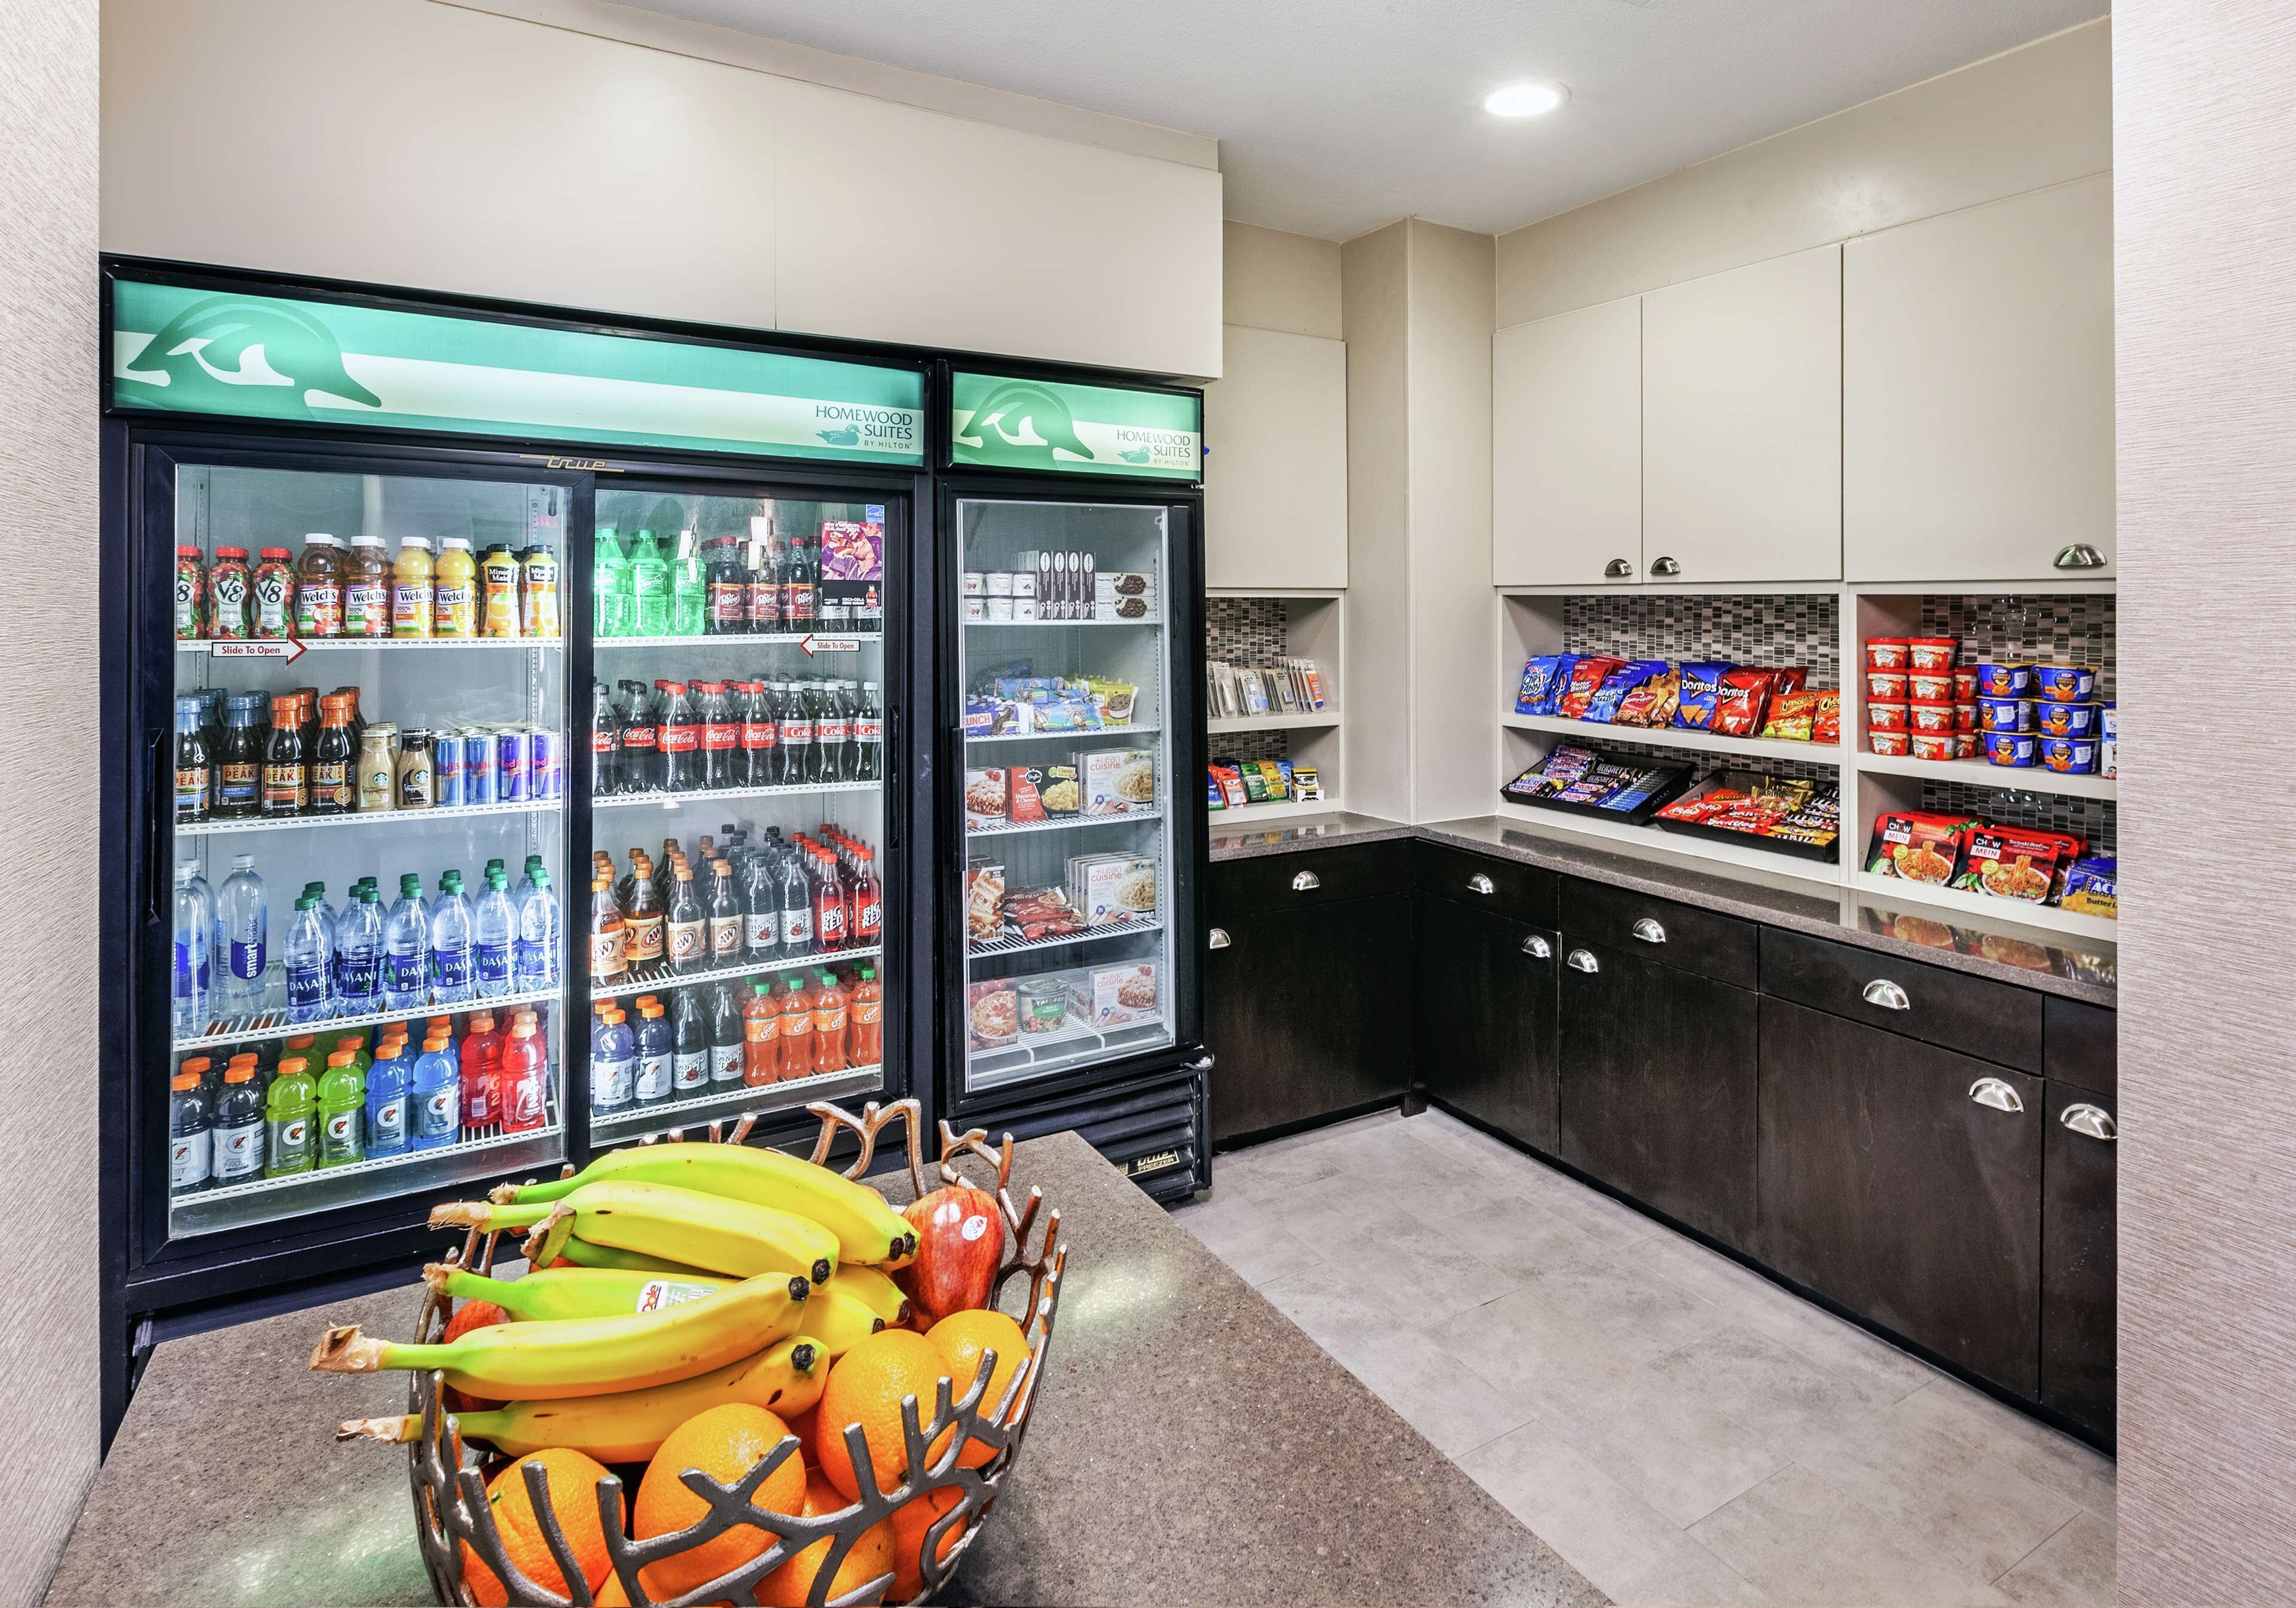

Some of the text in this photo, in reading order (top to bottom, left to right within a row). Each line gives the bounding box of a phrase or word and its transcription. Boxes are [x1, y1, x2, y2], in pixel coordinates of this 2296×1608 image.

[816, 405, 912, 426] HOMEWOOD
[865, 424, 912, 440] SUITES
[1116, 430, 1190, 446] HOMEWOOD
[1154, 445, 1190, 458] SUITES
[215, 578, 243, 603] V8
[256, 579, 282, 603] V8
[352, 591, 385, 602] Welch's
[719, 594, 738, 605] Pepper
[756, 594, 775, 605] Pepper
[795, 594, 813, 604] Pepper
[222, 646, 280, 656] Slide To Open
[1681, 679, 1717, 692] Doritos
[1781, 699, 1805, 712] Cheetos
[622, 727, 655, 741] Coca-Cola
[662, 730, 695, 744] Coca-Cola
[706, 729, 737, 743] Coca-Cola
[745, 727, 775, 742] Coca-Cola
[791, 726, 811, 737] Coke
[823, 725, 845, 736] Coke
[225, 771, 255, 779] PEAK
[266, 773, 294, 782] PEAK
[1888, 832, 1908, 842] MEIN
[1976, 838, 2001, 848] CHOW
[2009, 839, 2029, 847] Teriyaki
[1975, 848, 1998, 857] MEIN
[863, 900, 881, 918] BIG
[2087, 897, 2112, 907] Butter
[823, 905, 842, 922] BIG
[862, 911, 881, 929] RED
[822, 916, 843, 934] RED
[445, 958, 472, 973] DASA
[831, 1011, 845, 1029] Crush
[863, 1005, 880, 1022] Crush
[761, 1022, 776, 1040] Crush
[793, 1016, 810, 1034] Crush
